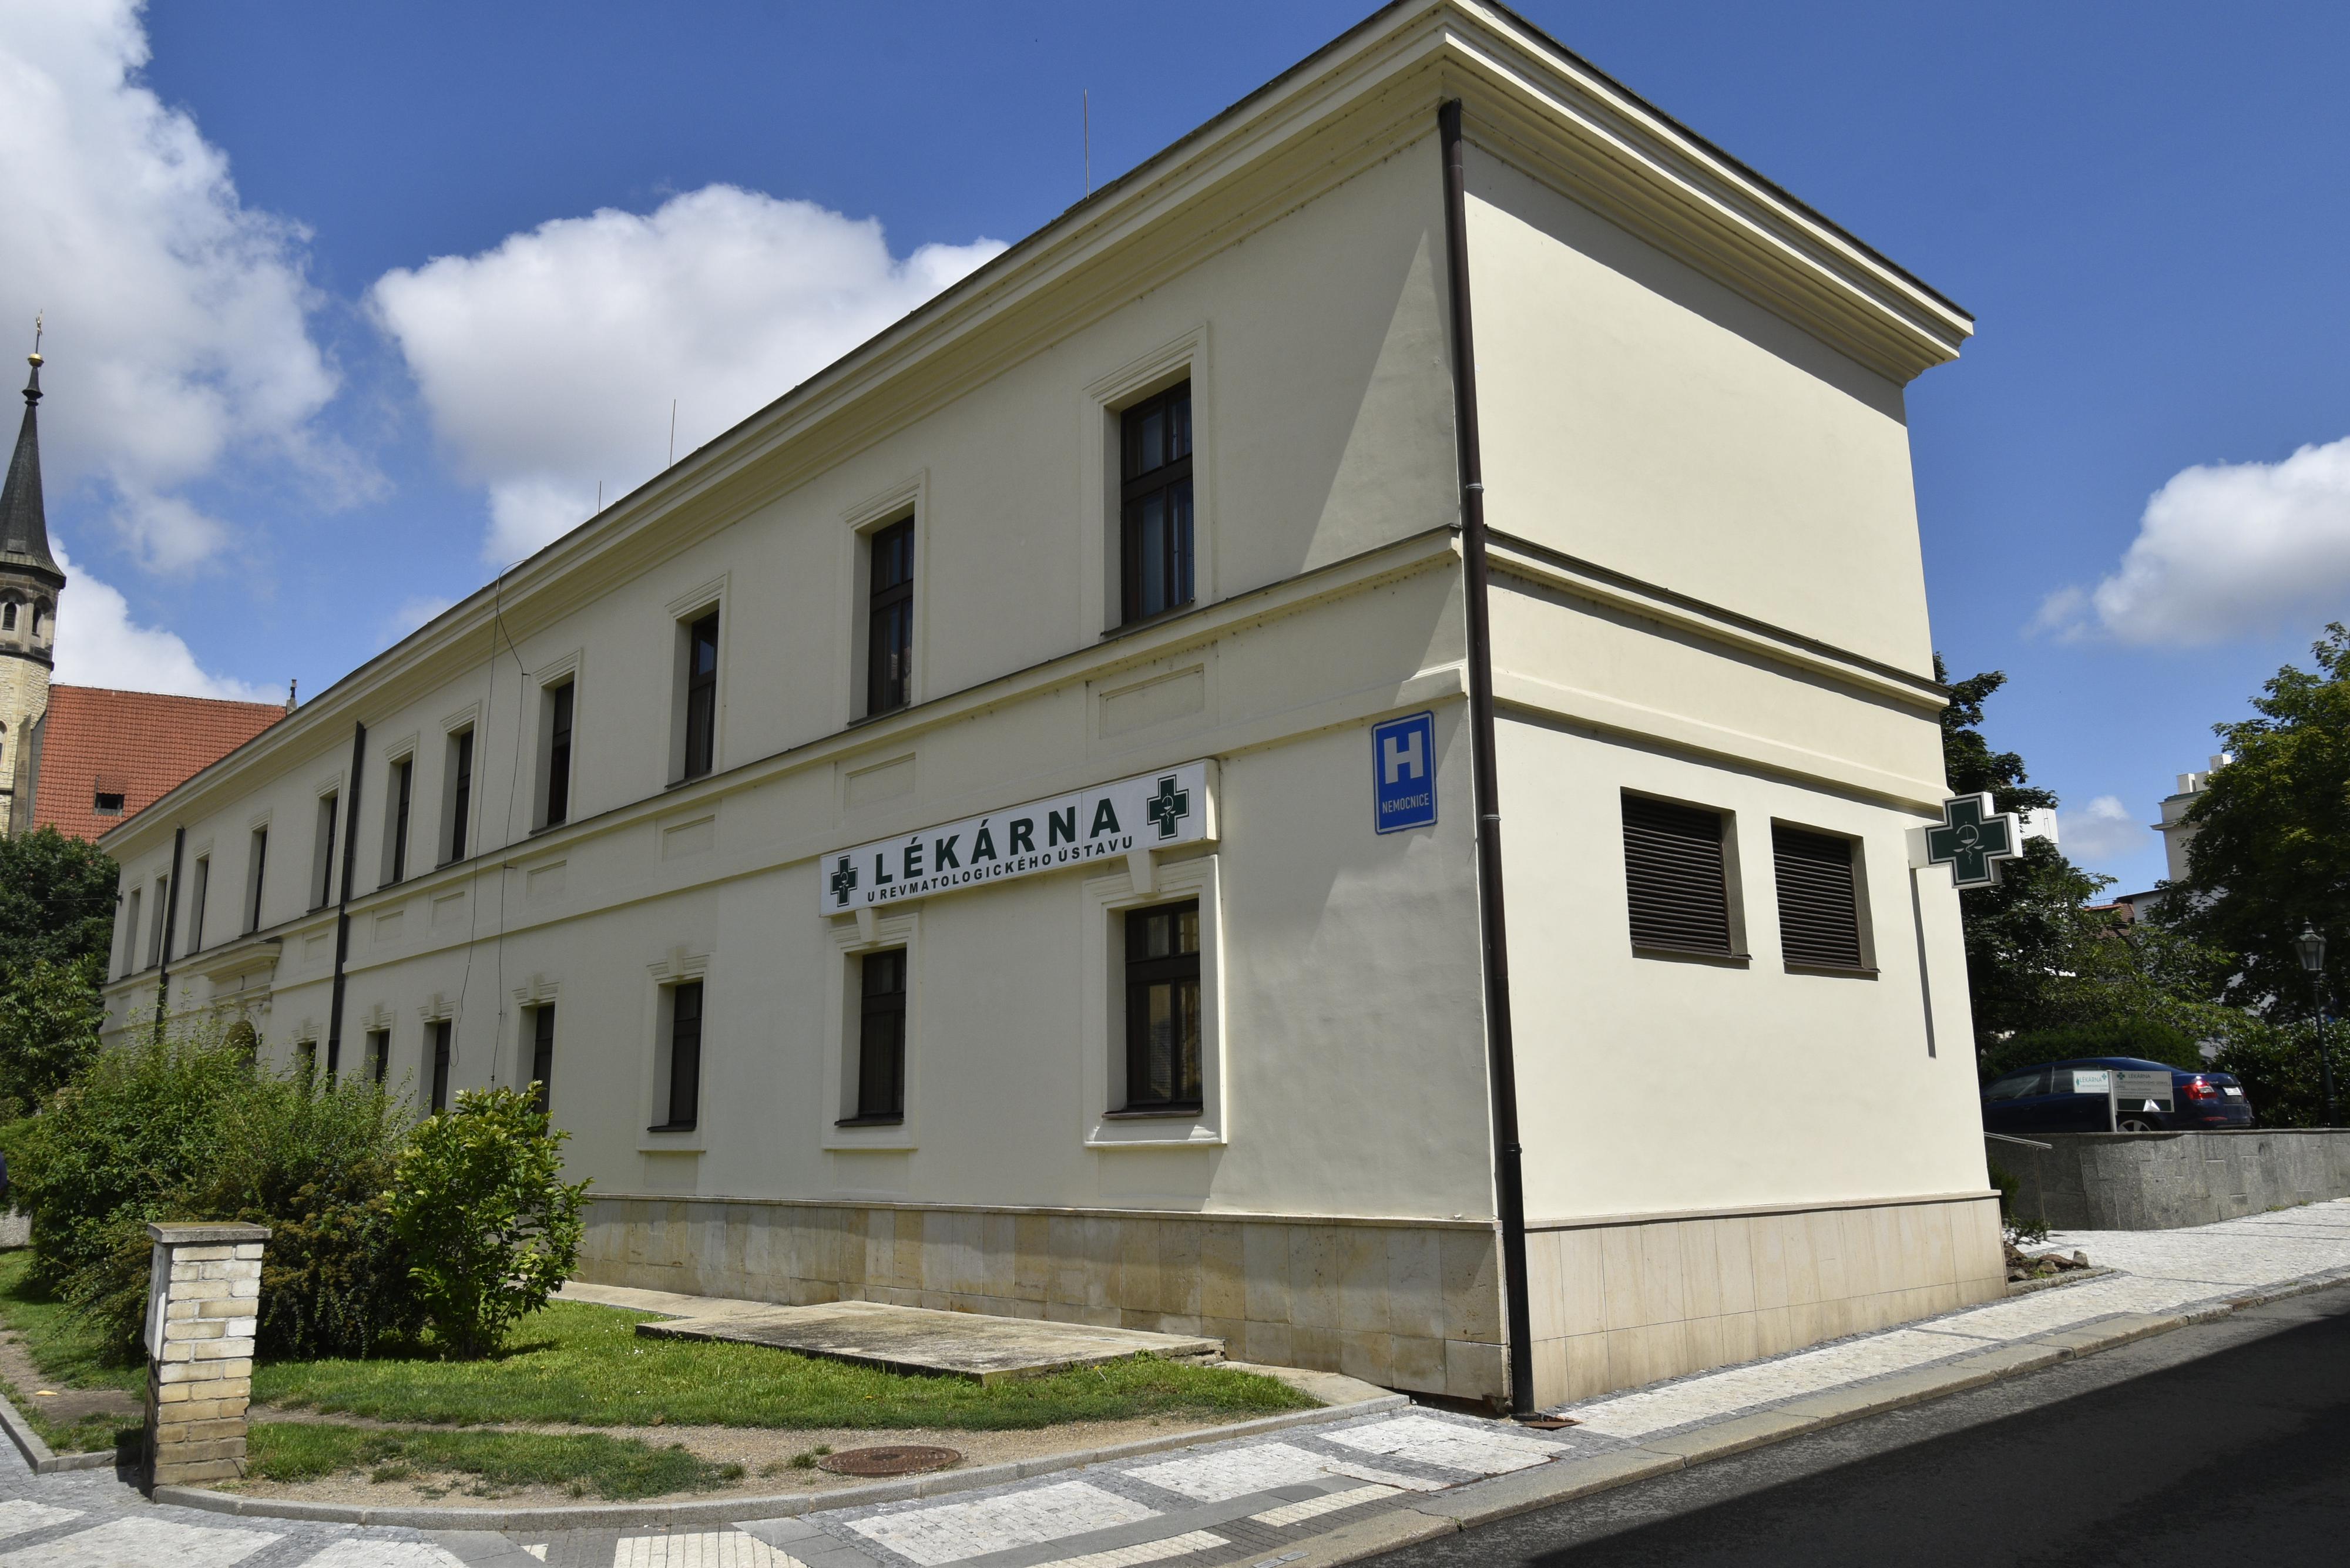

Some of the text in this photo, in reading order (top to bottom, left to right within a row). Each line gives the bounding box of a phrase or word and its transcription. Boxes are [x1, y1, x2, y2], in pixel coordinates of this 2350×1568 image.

[1383, 730, 1424, 784] H
[1382, 793, 1429, 814] NEMOCNICE
[868, 835, 1133, 902] U REVMATOLOGICKÉHO ÚSTAVU
[875, 798, 1121, 885] LÉKÁRNA
